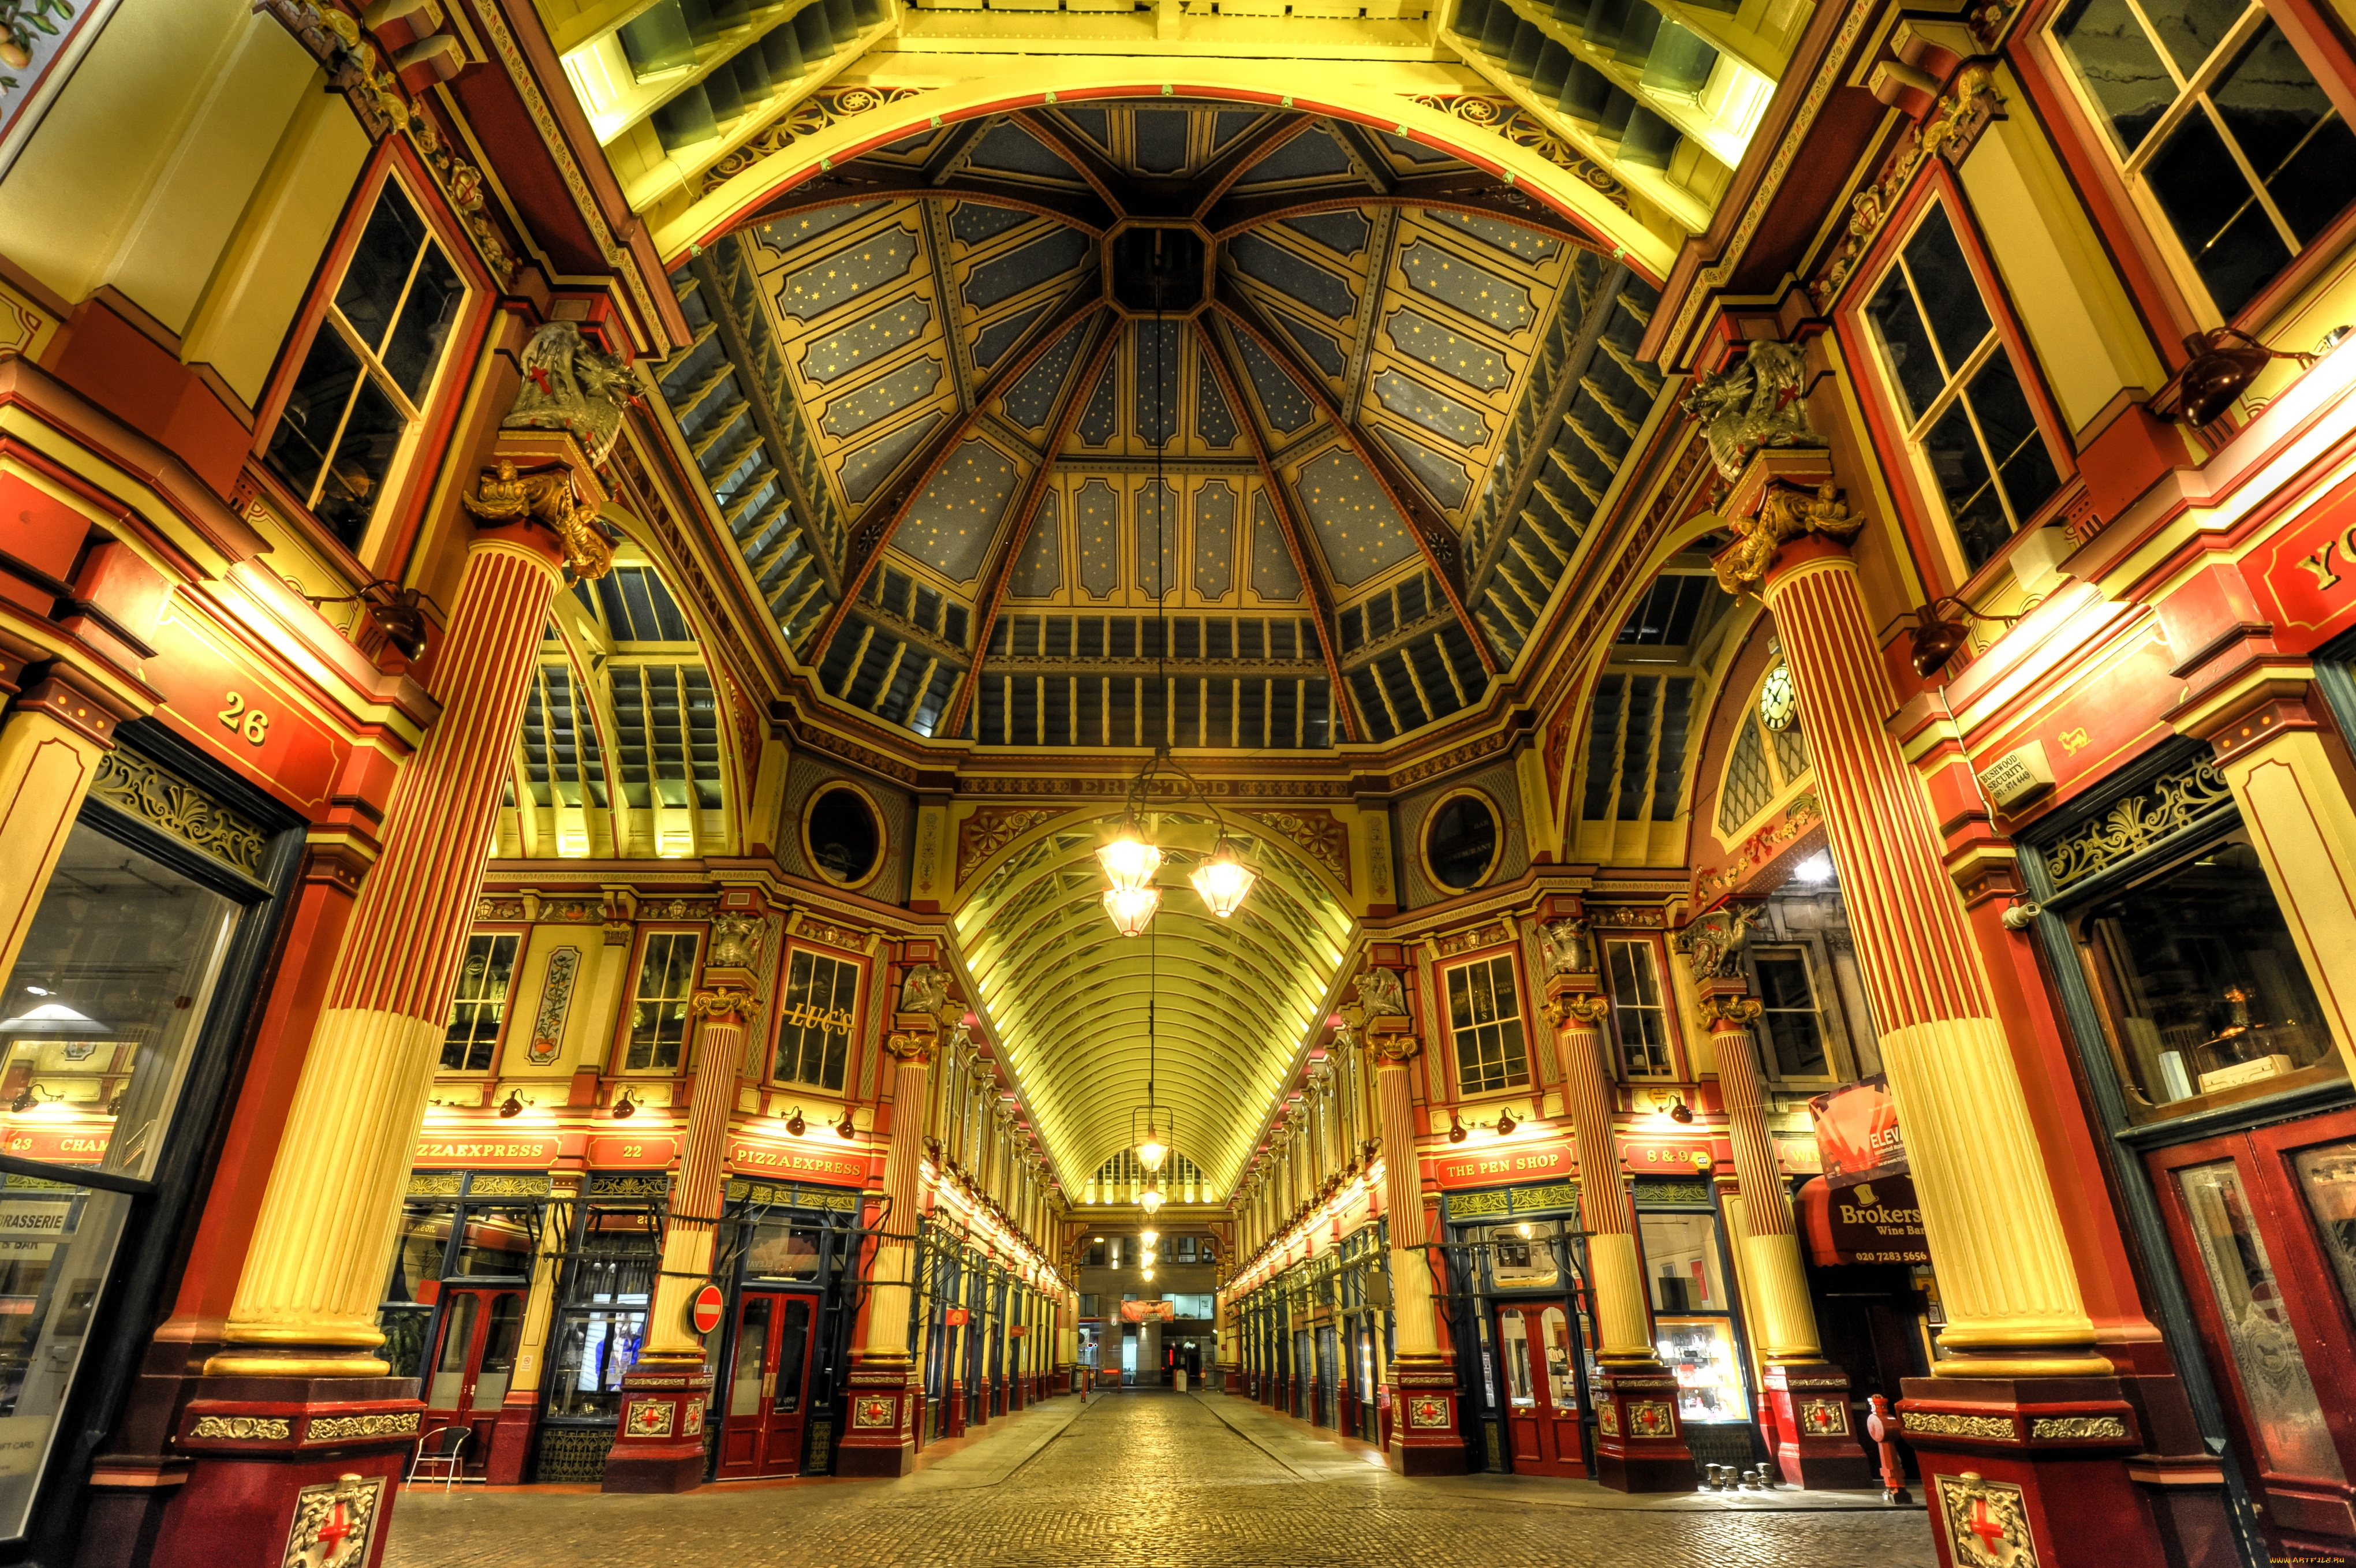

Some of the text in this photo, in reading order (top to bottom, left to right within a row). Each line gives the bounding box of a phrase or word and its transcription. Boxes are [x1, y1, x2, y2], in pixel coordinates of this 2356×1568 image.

[218, 691, 269, 747] 26
[1980, 755, 2017, 783] BUSHWOOD
[1987, 762, 2023, 791] SECURITY
[1080, 780, 1230, 795] ERECTED
[788, 1002, 852, 1035] LUC'S
[11, 1138, 32, 1151] 23
[1870, 1126, 1903, 1149] ELEV
[416, 1144, 543, 1157] ZZAEXPRESS
[623, 1145, 642, 1158] 22
[1646, 1149, 1689, 1163] 8 & 9
[737, 1149, 861, 1176] PIZZAEXPRESS
[1447, 1154, 1559, 1178] THE PEN SHOP
[1839, 1205, 1922, 1223] Brokers
[1876, 1225, 1925, 1235] Wine Bar
[1856, 1252, 1927, 1261] 020 7283 5656
